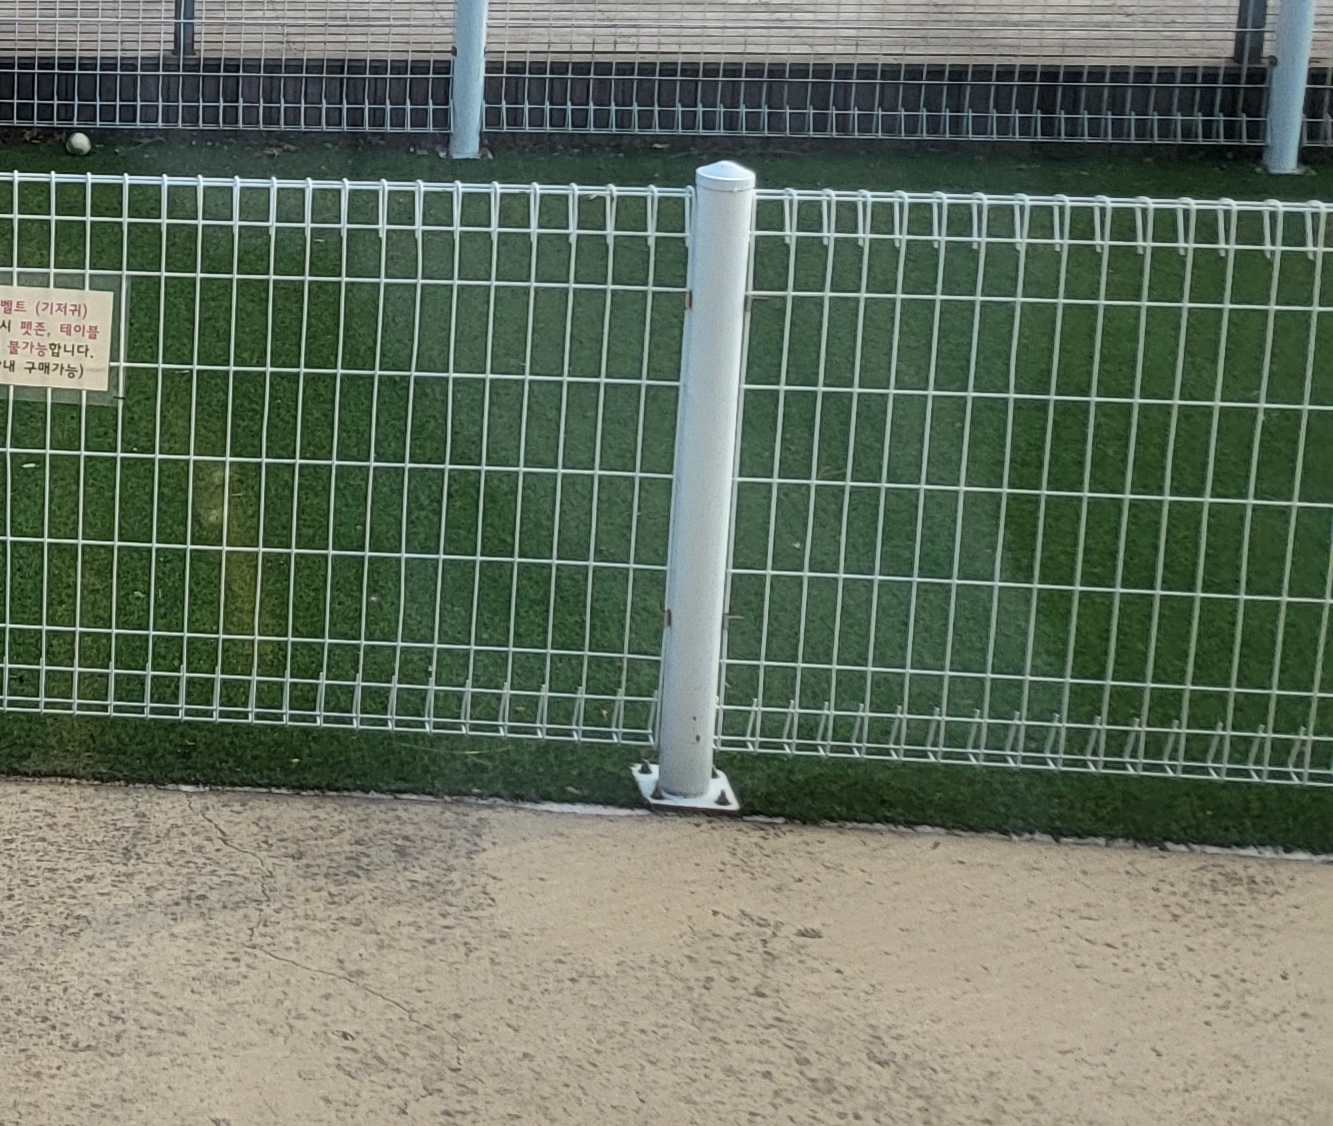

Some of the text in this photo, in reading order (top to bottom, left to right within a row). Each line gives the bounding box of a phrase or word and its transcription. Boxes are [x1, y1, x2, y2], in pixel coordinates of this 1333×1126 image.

[35, 301, 88, 319] (기저귀)
[20, 320, 51, 337] 펫존,
[59, 323, 100, 340] 테이블
[7, 339, 94, 359] 불가능합니다.
[23, 360, 84, 380] 구매가능)
